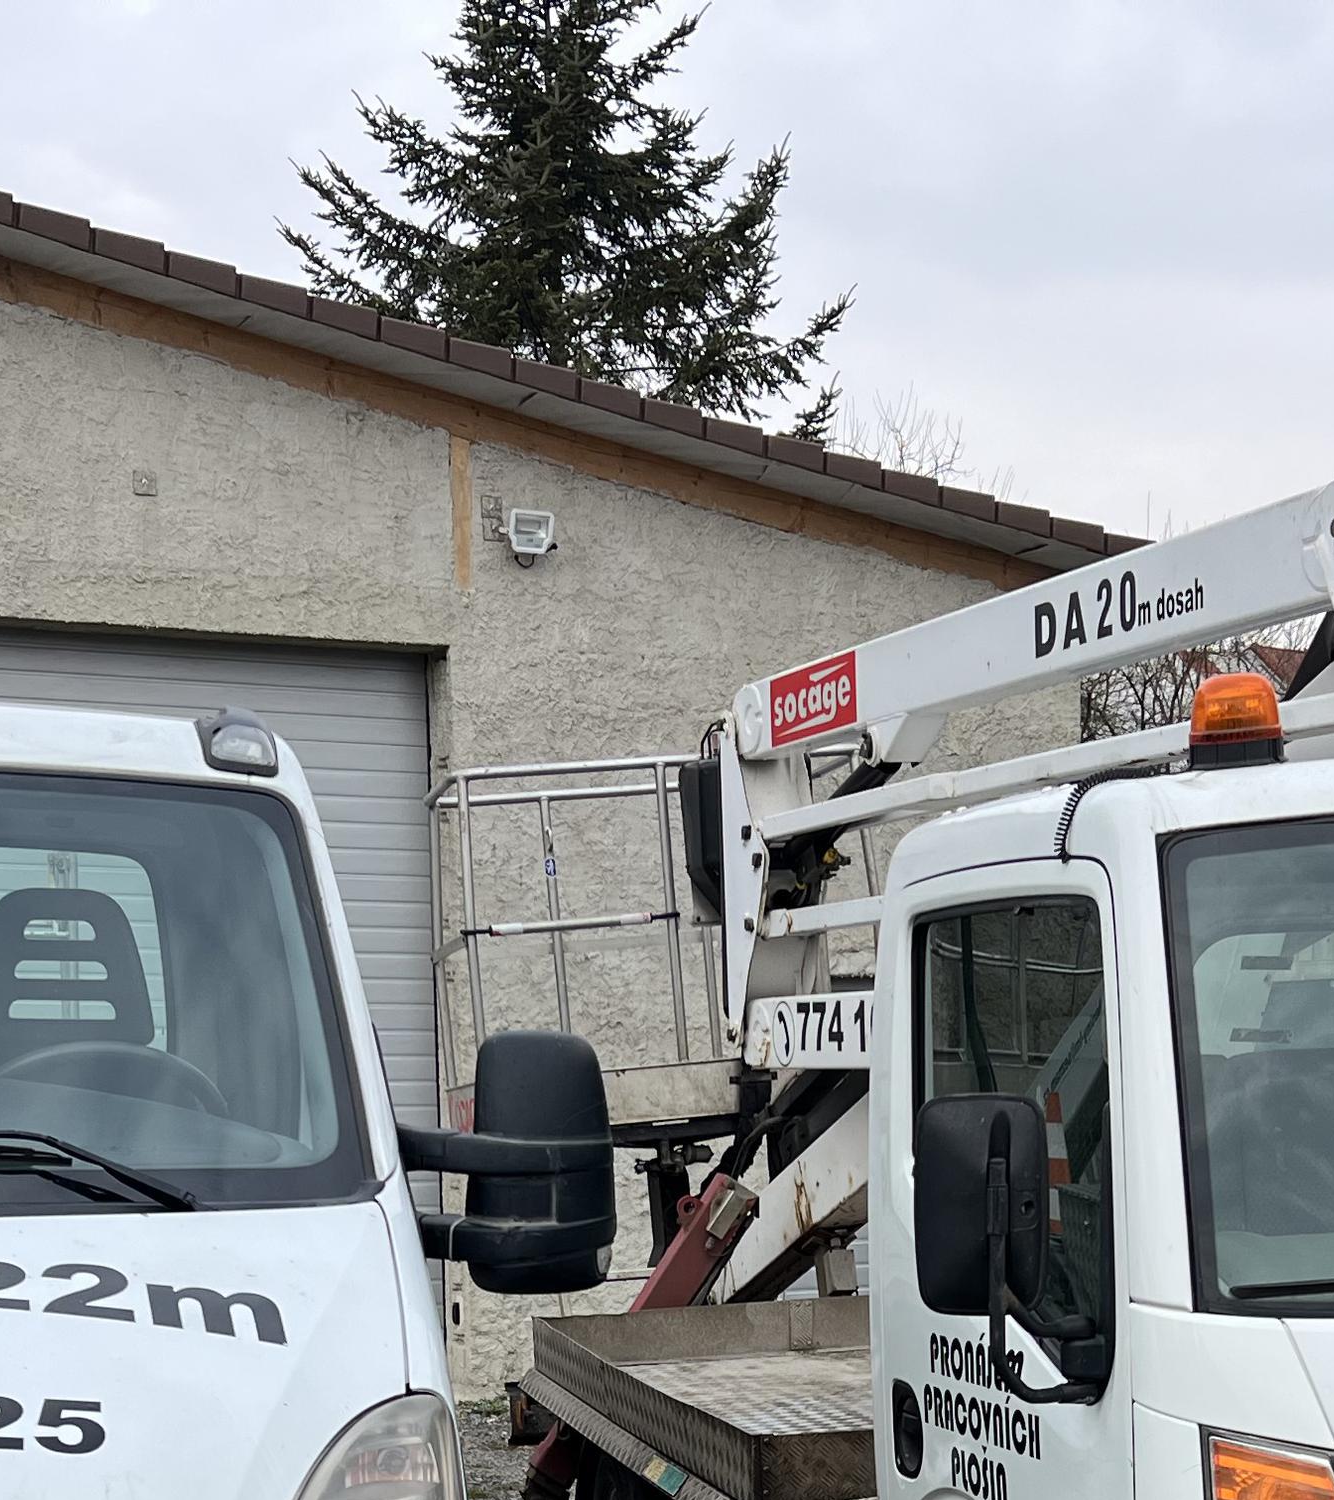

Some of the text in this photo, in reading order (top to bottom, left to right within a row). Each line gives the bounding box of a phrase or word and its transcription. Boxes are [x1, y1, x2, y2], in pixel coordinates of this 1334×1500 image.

[1034, 570, 1204, 659] DA 20m dosah
[773, 674, 852, 732] socage
[796, 999, 874, 1052] 774 1
[923, 1383, 1041, 1460] PRACOVNÍCH
